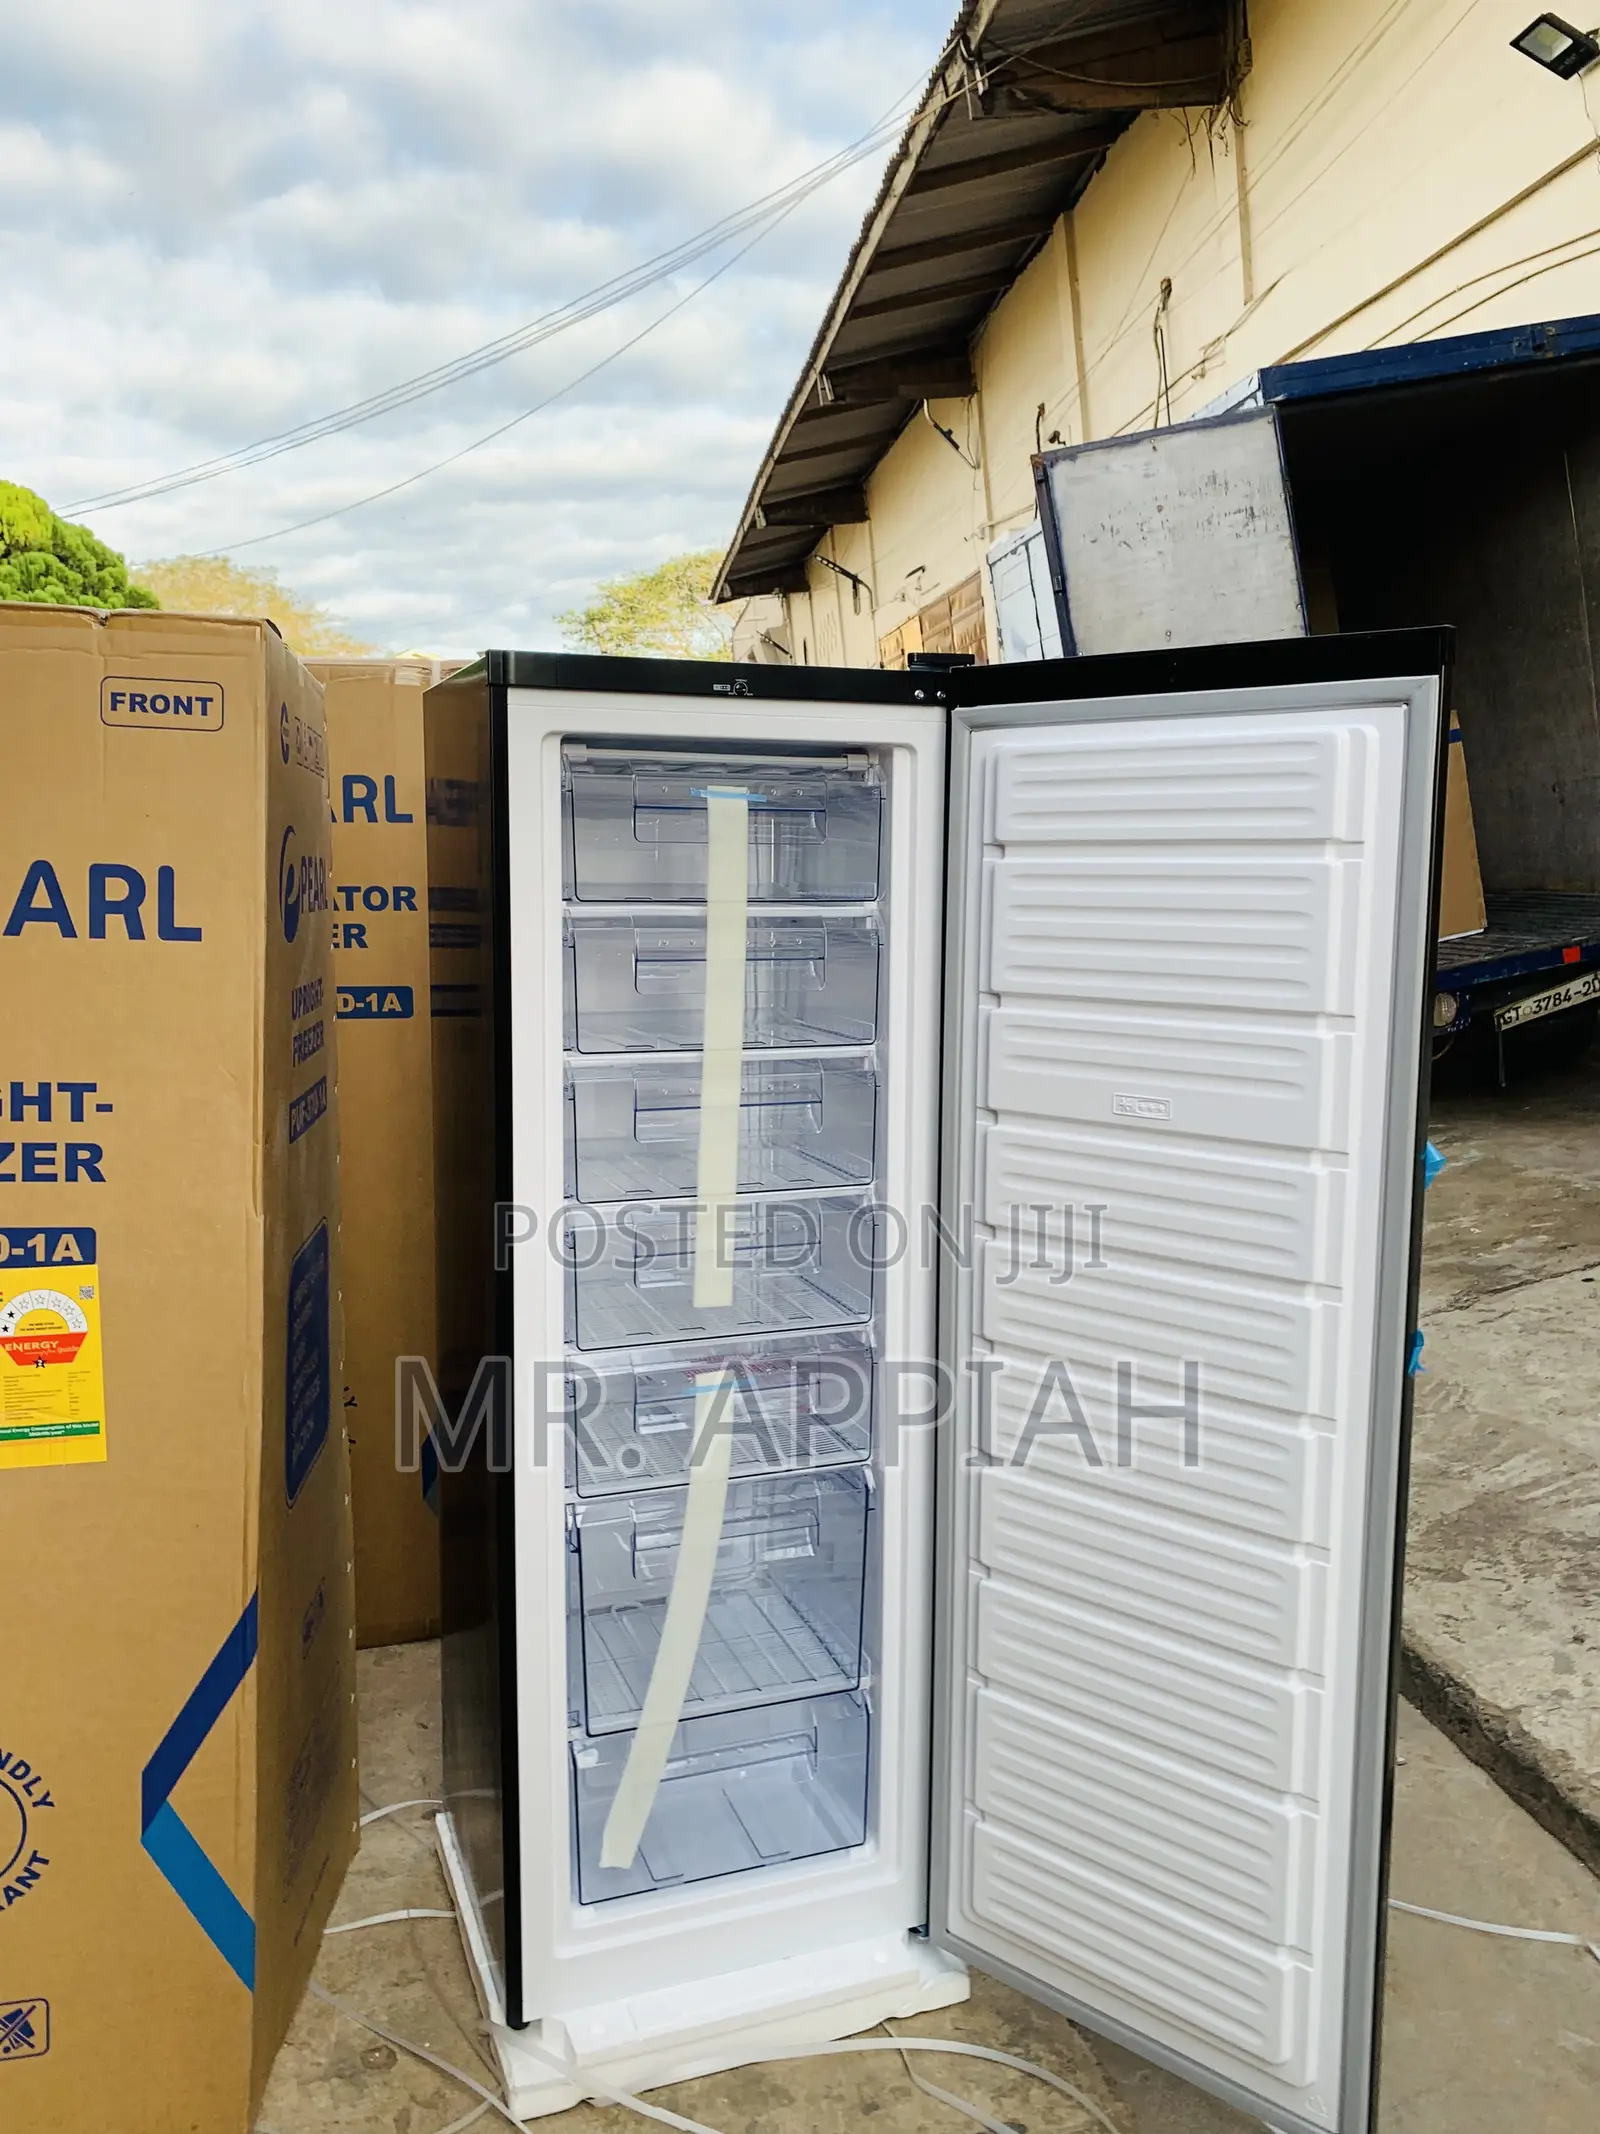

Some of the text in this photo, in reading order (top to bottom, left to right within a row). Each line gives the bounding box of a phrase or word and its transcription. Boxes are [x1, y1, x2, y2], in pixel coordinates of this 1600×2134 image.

[110, 692, 213, 717] FRONT
[331, 775, 413, 824] RL
[2, 859, 202, 941] ARL
[0, 1082, 113, 1123] HT-
[4, 1340, 59, 1353] ENERGY
[0, 1850, 50, 1912] ANT
